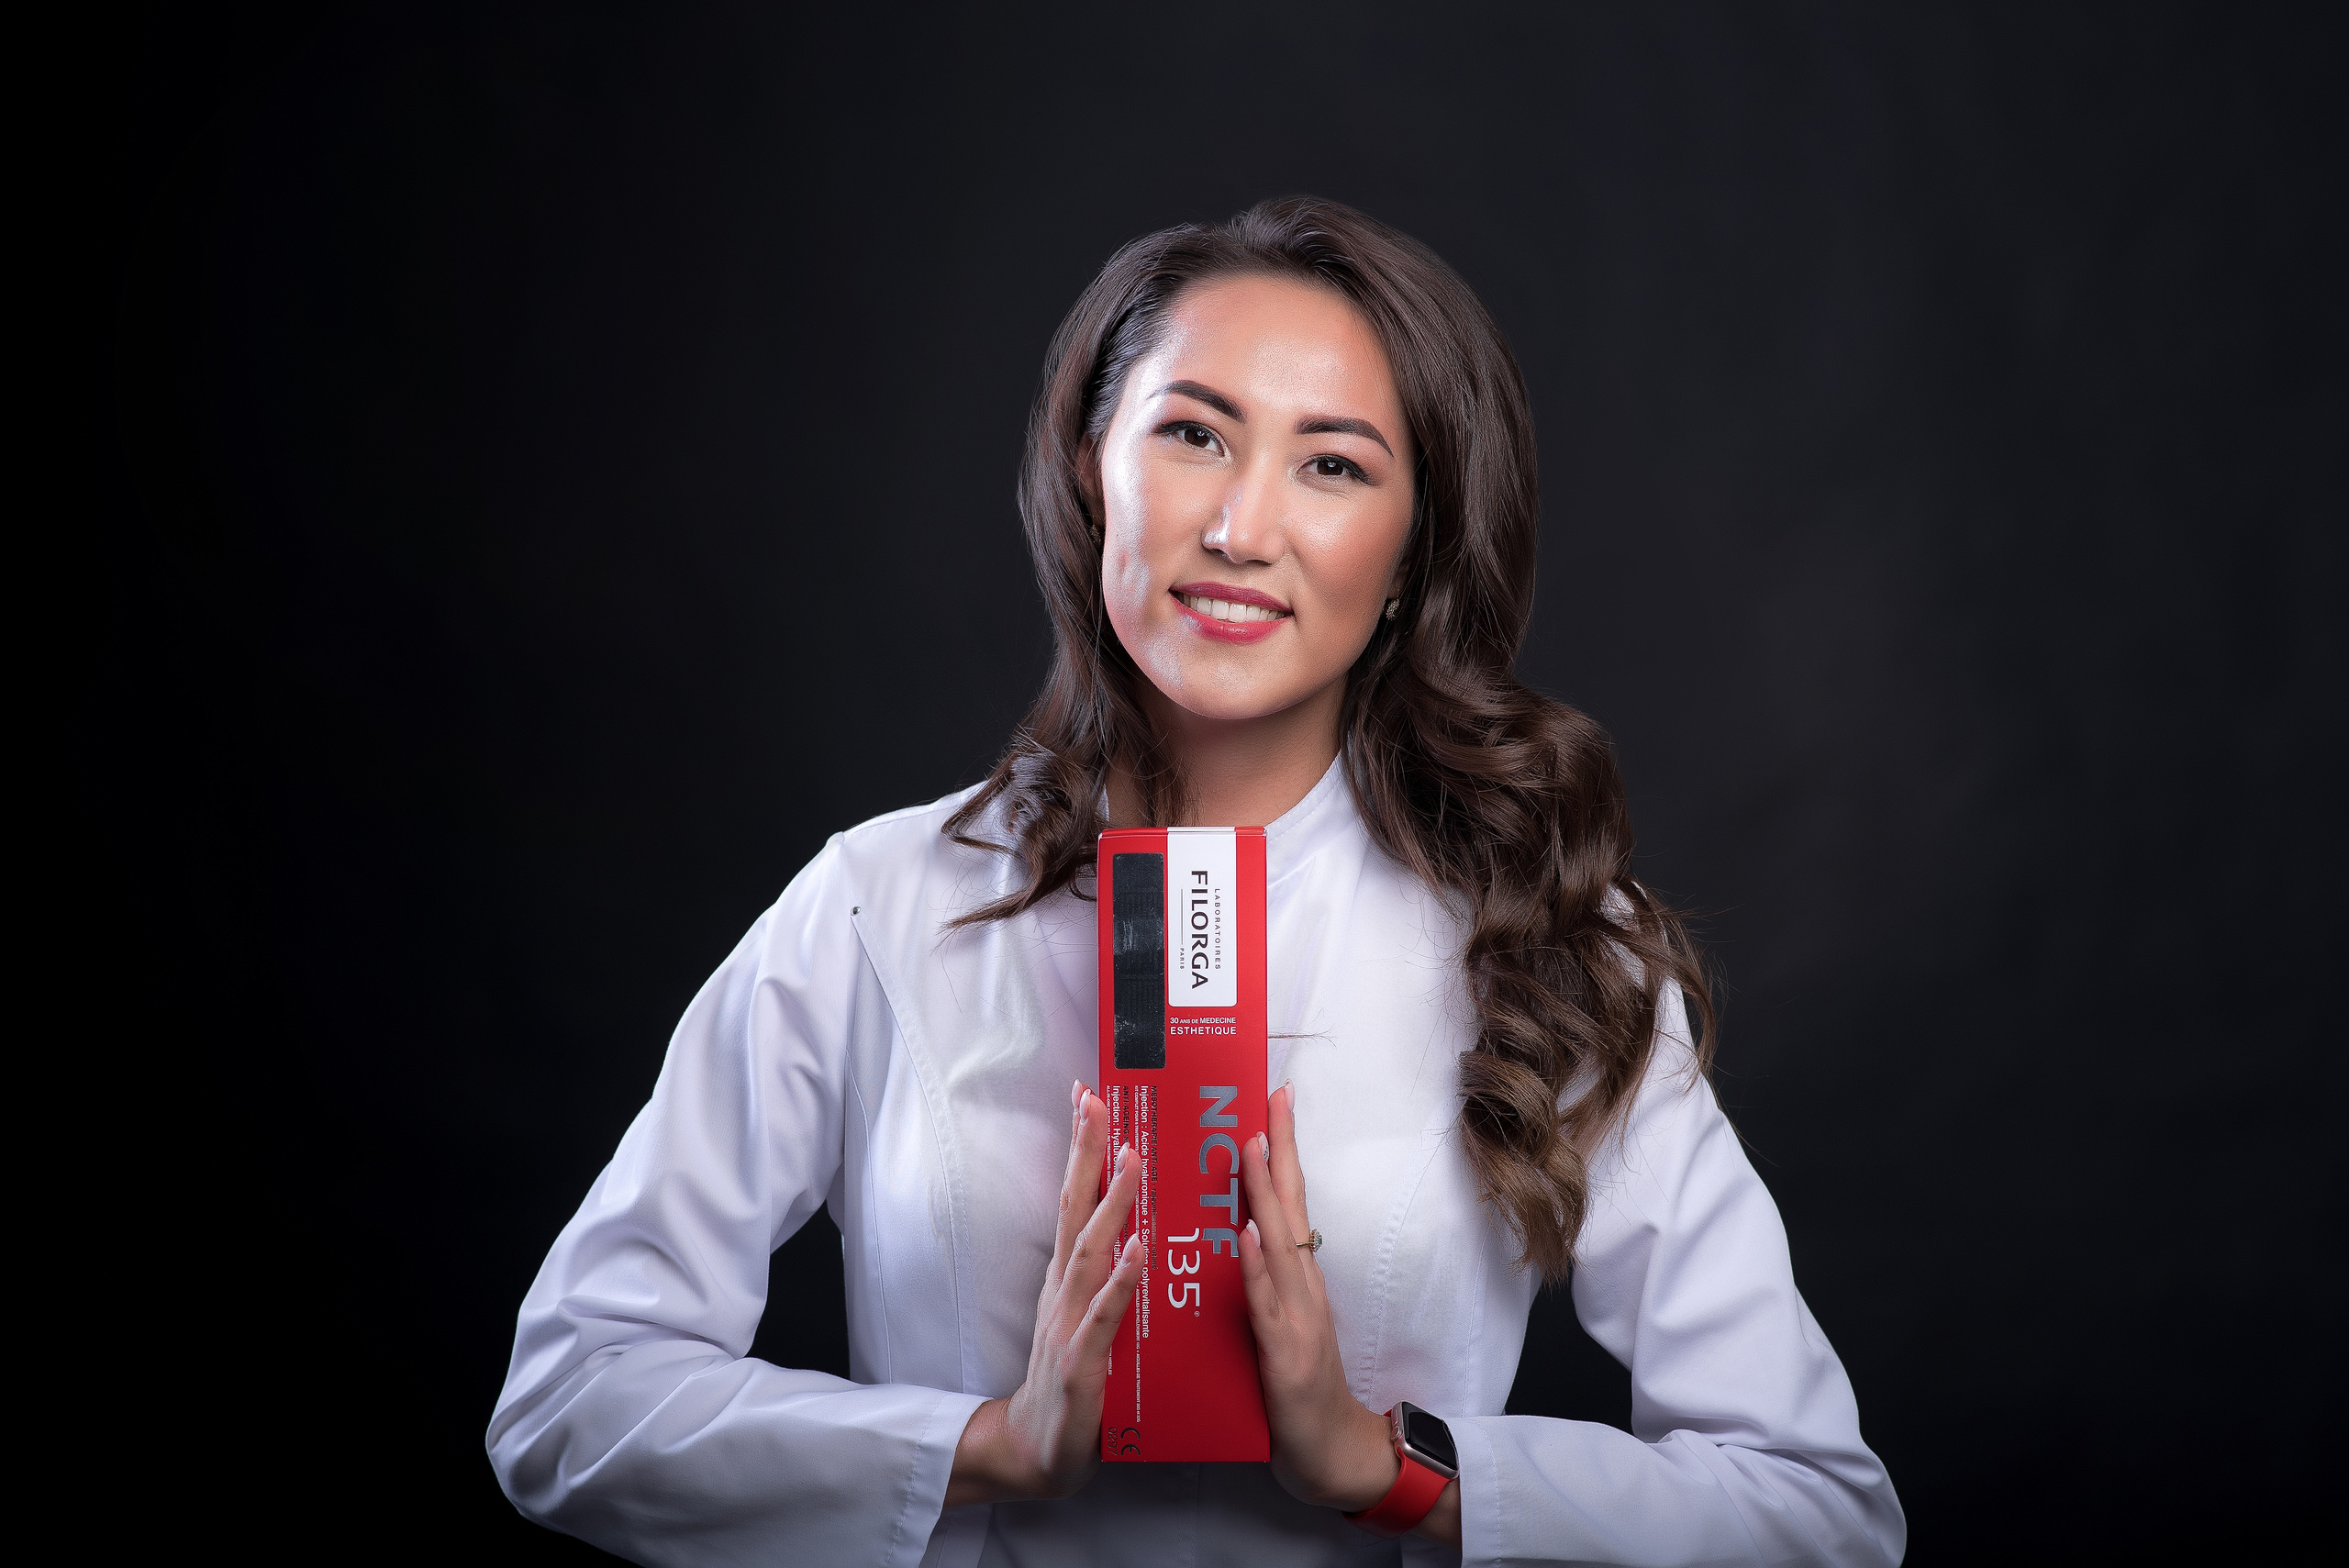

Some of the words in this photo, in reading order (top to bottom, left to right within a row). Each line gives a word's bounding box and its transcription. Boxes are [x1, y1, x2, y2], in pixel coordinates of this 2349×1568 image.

[1191, 870, 1209, 990] FILORGA
[1170, 1026, 1237, 1035] ESTHETIQUE
[1111, 1085, 1121, 1126] Injection:
[1139, 1085, 1150, 1123] Injection
[1141, 1130, 1150, 1156] Acide
[1140, 1158, 1150, 1216] hyaluronique
[1199, 1085, 1240, 1258] NCTF
[1140, 1266, 1151, 1339] polyrevitalisante
[1108, 1427, 1118, 1456] 0297
